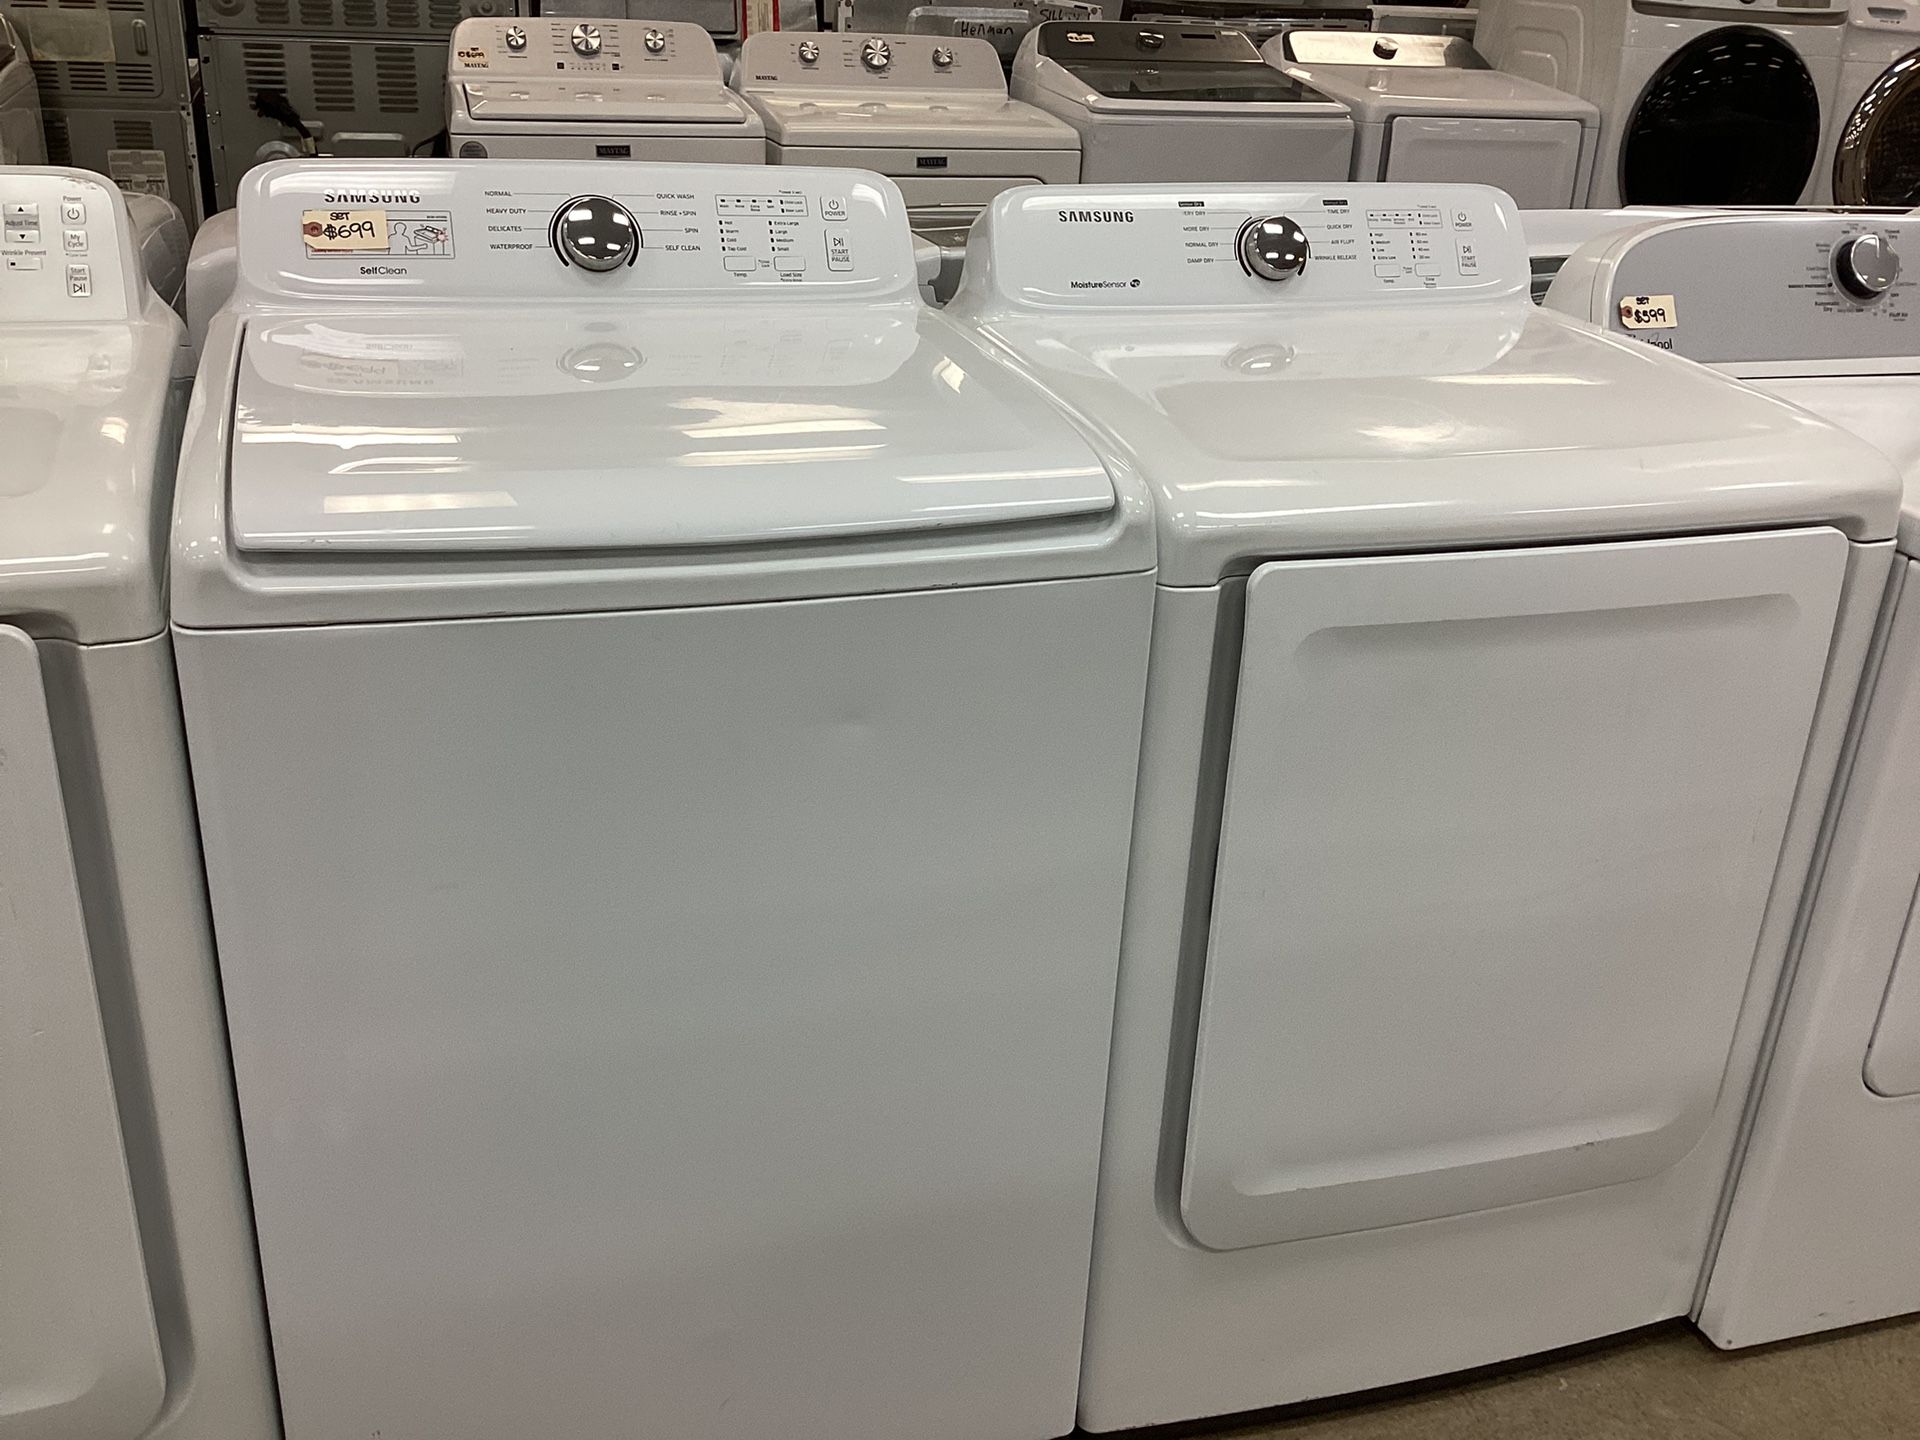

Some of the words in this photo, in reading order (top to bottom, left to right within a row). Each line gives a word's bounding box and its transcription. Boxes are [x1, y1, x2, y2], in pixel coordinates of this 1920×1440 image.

[324, 188, 421, 204] SAMSUNG
[1058, 210, 1135, 223] SAMSUNG
[323, 221, 375, 240] $699
[70, 234, 81, 242] My
[360, 266, 408, 275] SelfClean
[1071, 280, 1127, 289] MoistureSensor
[1634, 308, 1666, 324] $599
